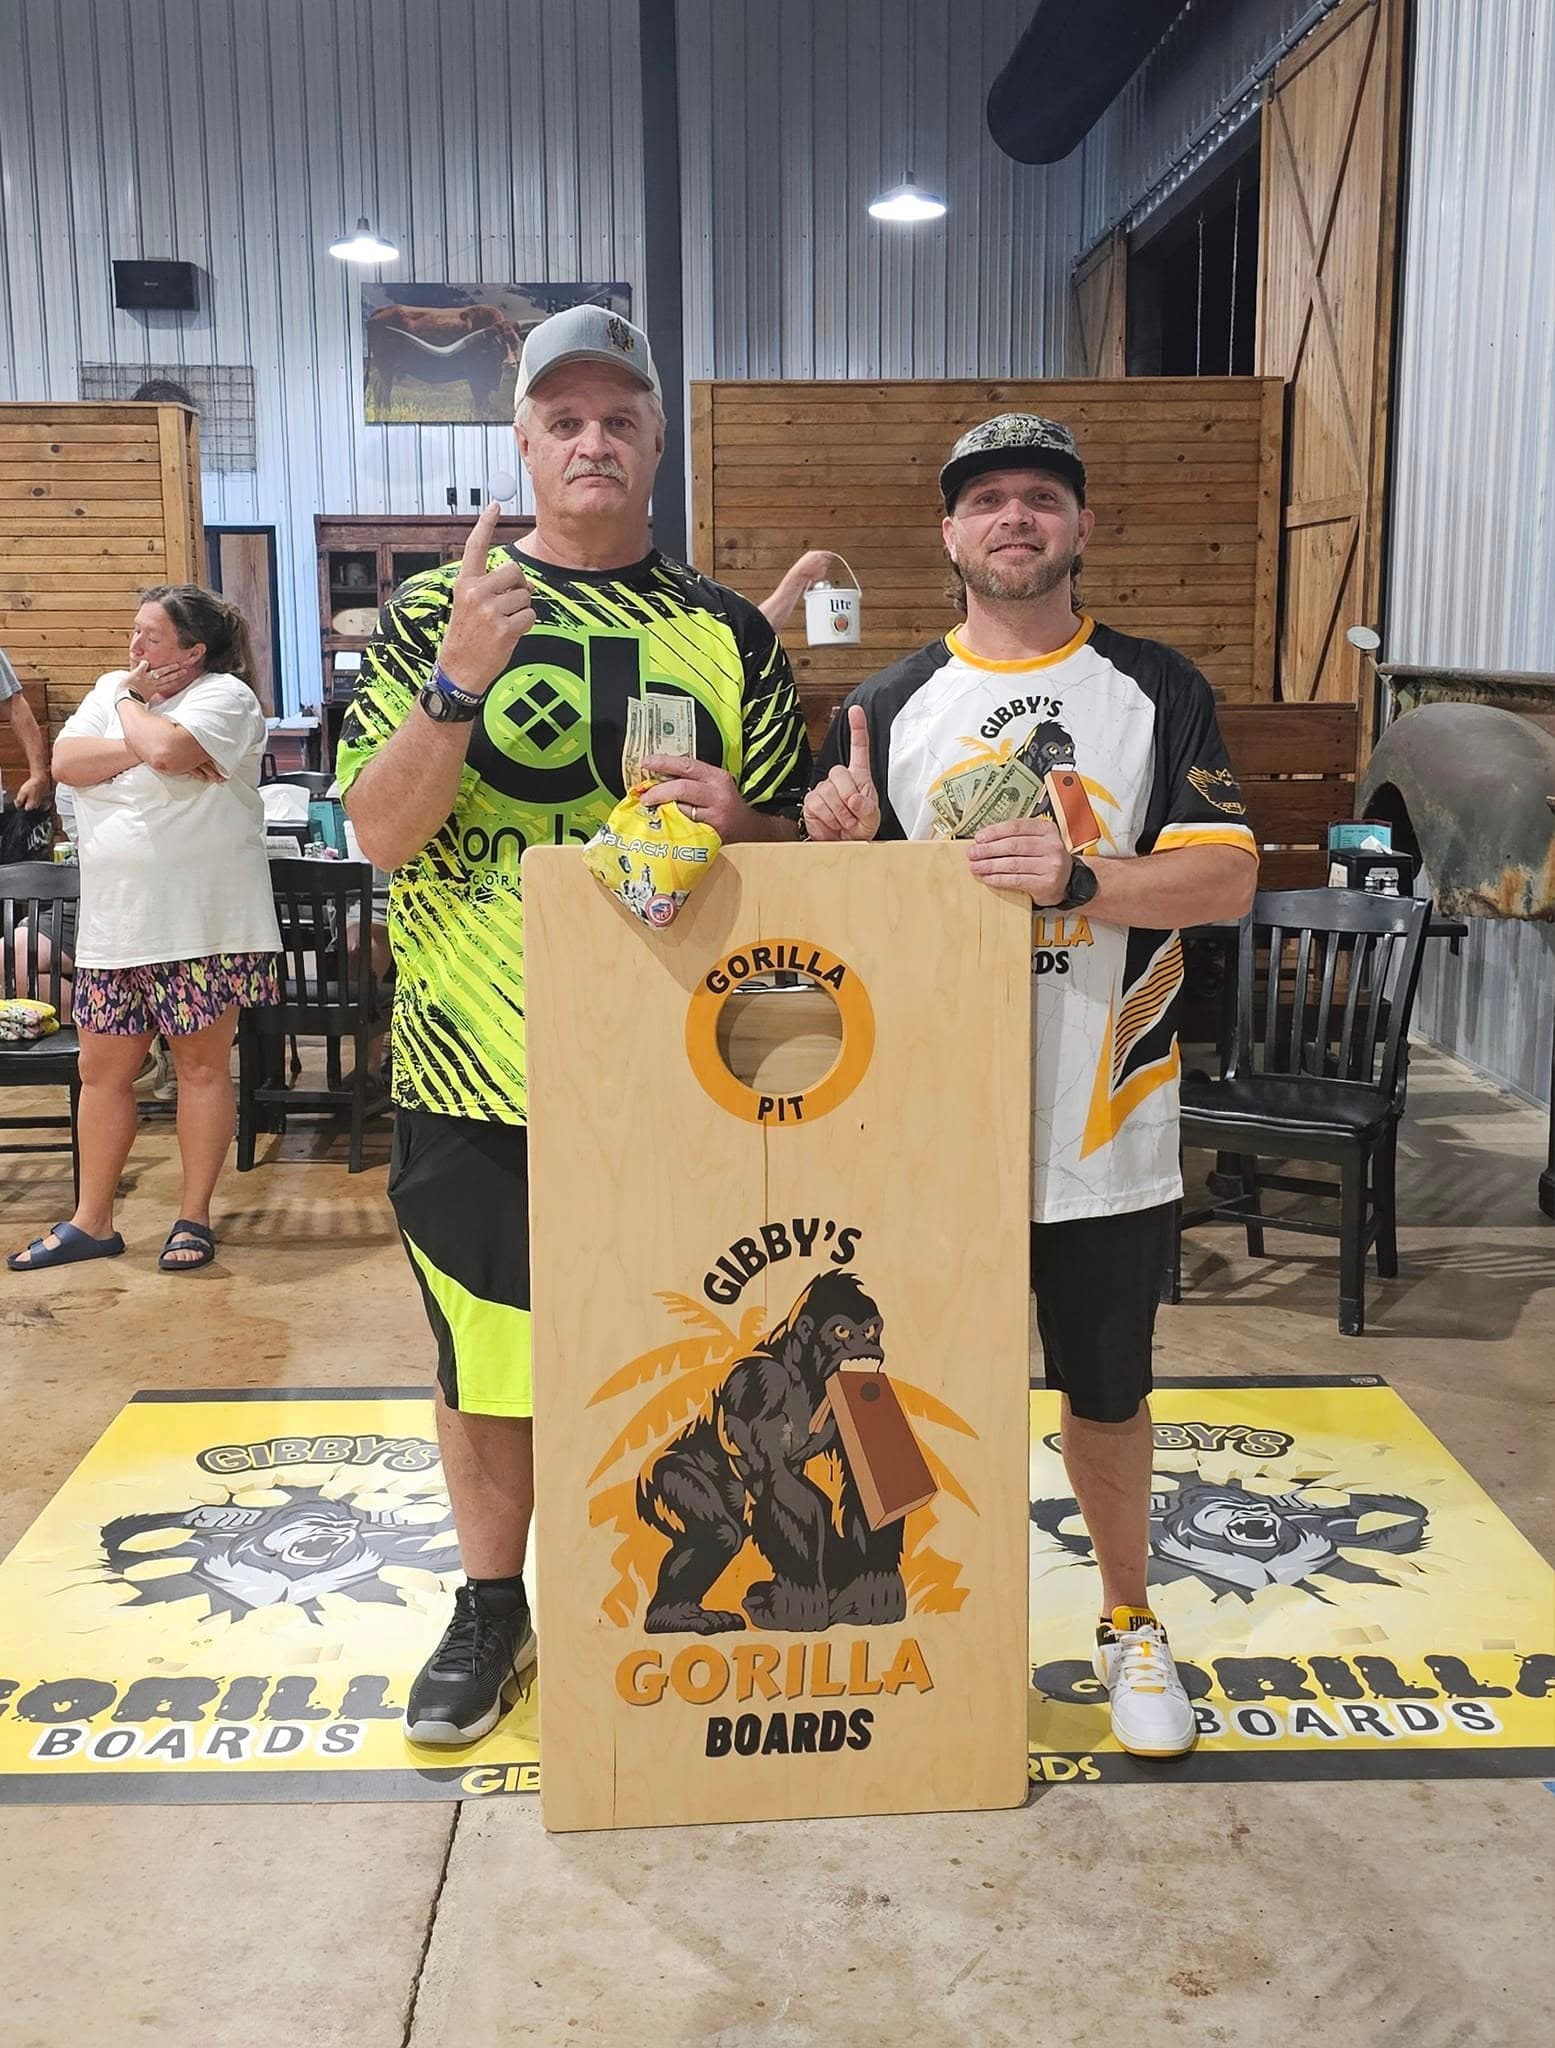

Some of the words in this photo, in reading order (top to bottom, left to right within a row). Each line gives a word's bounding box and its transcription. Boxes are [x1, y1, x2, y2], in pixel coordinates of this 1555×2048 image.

[830, 599, 852, 613] Lite
[980, 696, 1063, 739] GIBBY'S
[602, 833, 668, 858] BLACK
[671, 845, 708, 862] ICE
[706, 945, 846, 994] GORILLA
[1032, 951, 1070, 975] DS
[757, 1095, 804, 1121] PIT
[703, 1218, 862, 1305] GIBBY'S
[197, 1435, 440, 1474] GIBBY'S
[615, 1638, 934, 1706] GORILLA
[705, 1708, 874, 1758] BOARDS
[1192, 1703, 1496, 1737] BOARDS
[37, 1724, 360, 1760] BOARDS
